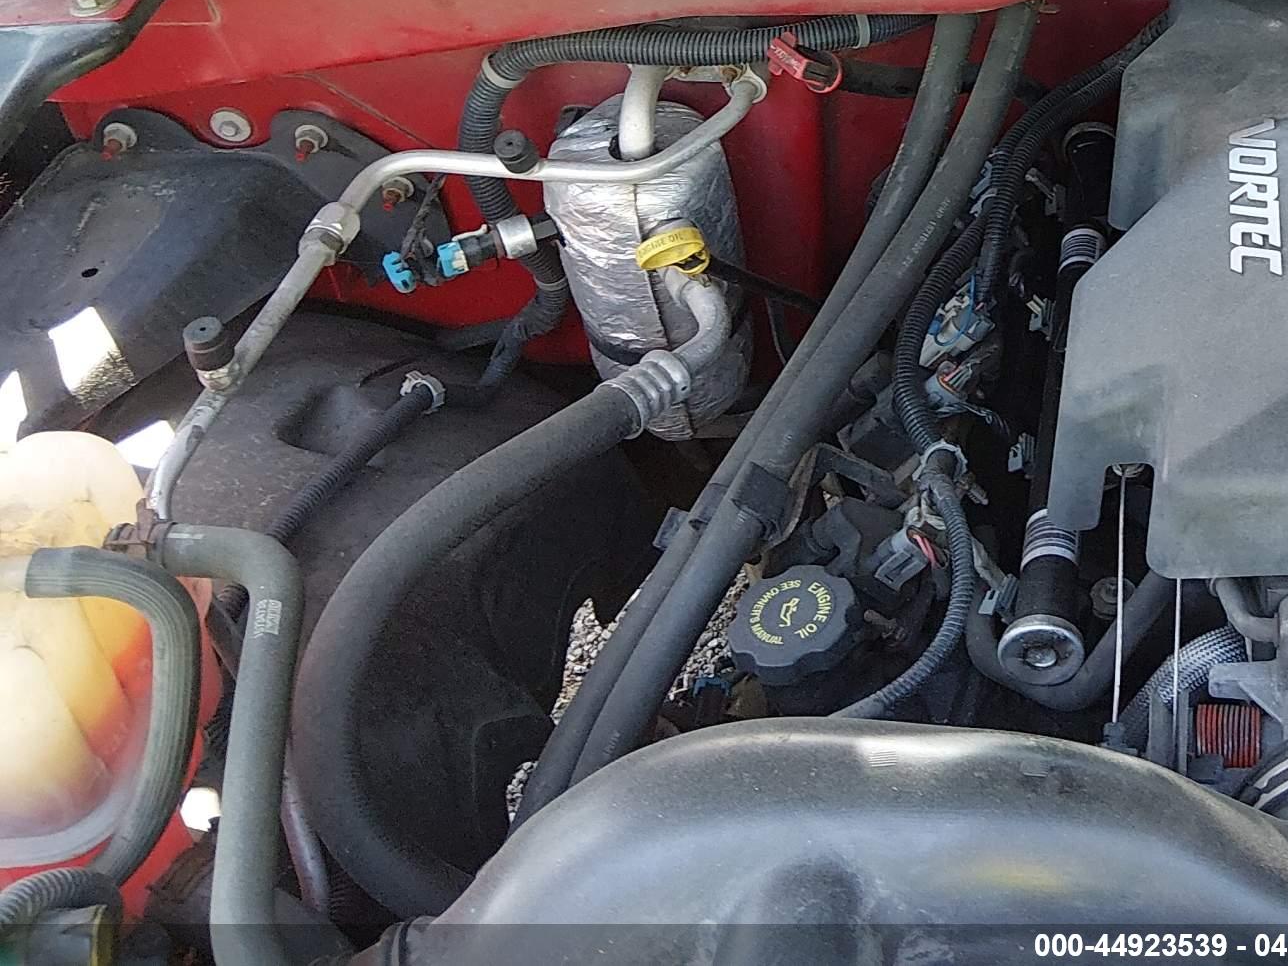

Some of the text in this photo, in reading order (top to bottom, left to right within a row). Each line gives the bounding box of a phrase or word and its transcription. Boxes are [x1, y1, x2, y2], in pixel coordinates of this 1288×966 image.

[1228, 118, 1283, 276] VORTEC
[780, 579, 801, 591] SEE
[794, 581, 833, 639] ENGINE OIL
[750, 623, 785, 645] MANUAL
